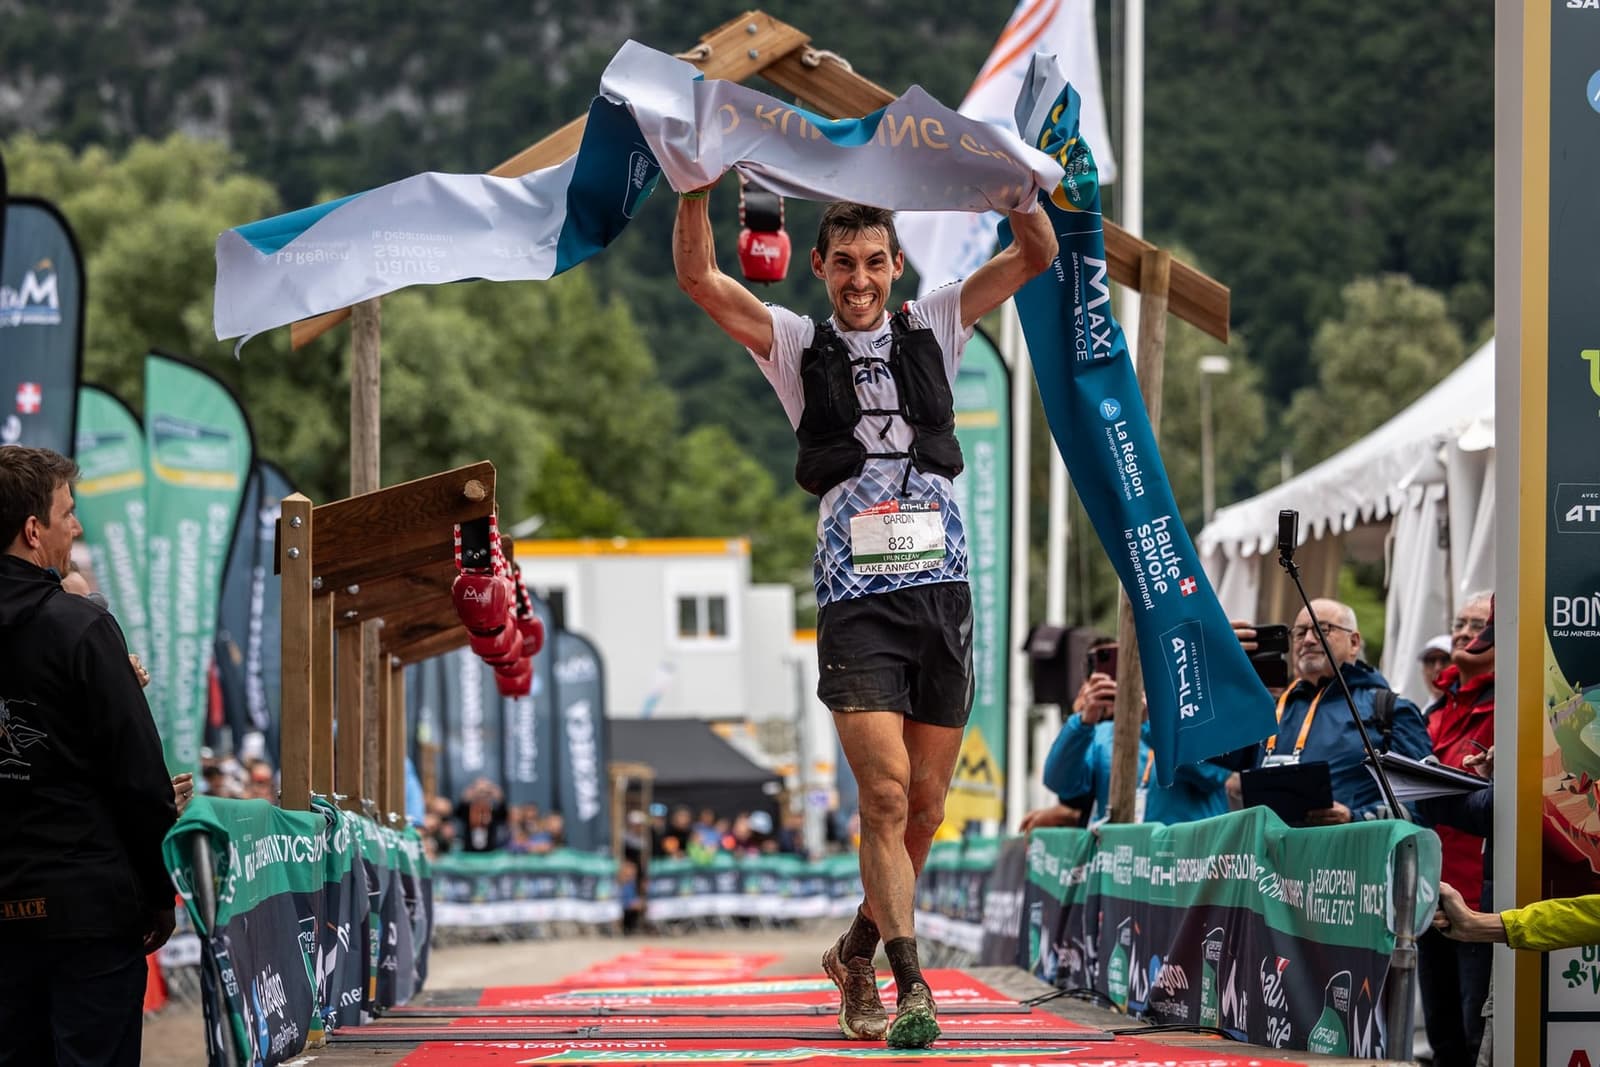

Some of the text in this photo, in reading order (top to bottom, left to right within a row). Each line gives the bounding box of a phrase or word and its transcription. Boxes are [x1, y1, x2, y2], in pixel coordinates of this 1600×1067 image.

[1054, 259, 1065, 282] WITH
[1071, 251, 1080, 304] SALOMON
[1074, 314, 1089, 361] RACE
[1114, 420, 1146, 498] La Région
[859, 563, 883, 574] LAKE
[884, 561, 921, 573] ANNECY
[888, 536, 914, 551] 823
[1136, 522, 1169, 595] savoie
[1151, 514, 1182, 580] haute
[1123, 528, 1156, 611] le Département
[1171, 636, 1200, 720] ATHLÉ
[1314, 869, 1357, 897] EUROPEAN
[1312, 897, 1355, 927] ATHLETICS
